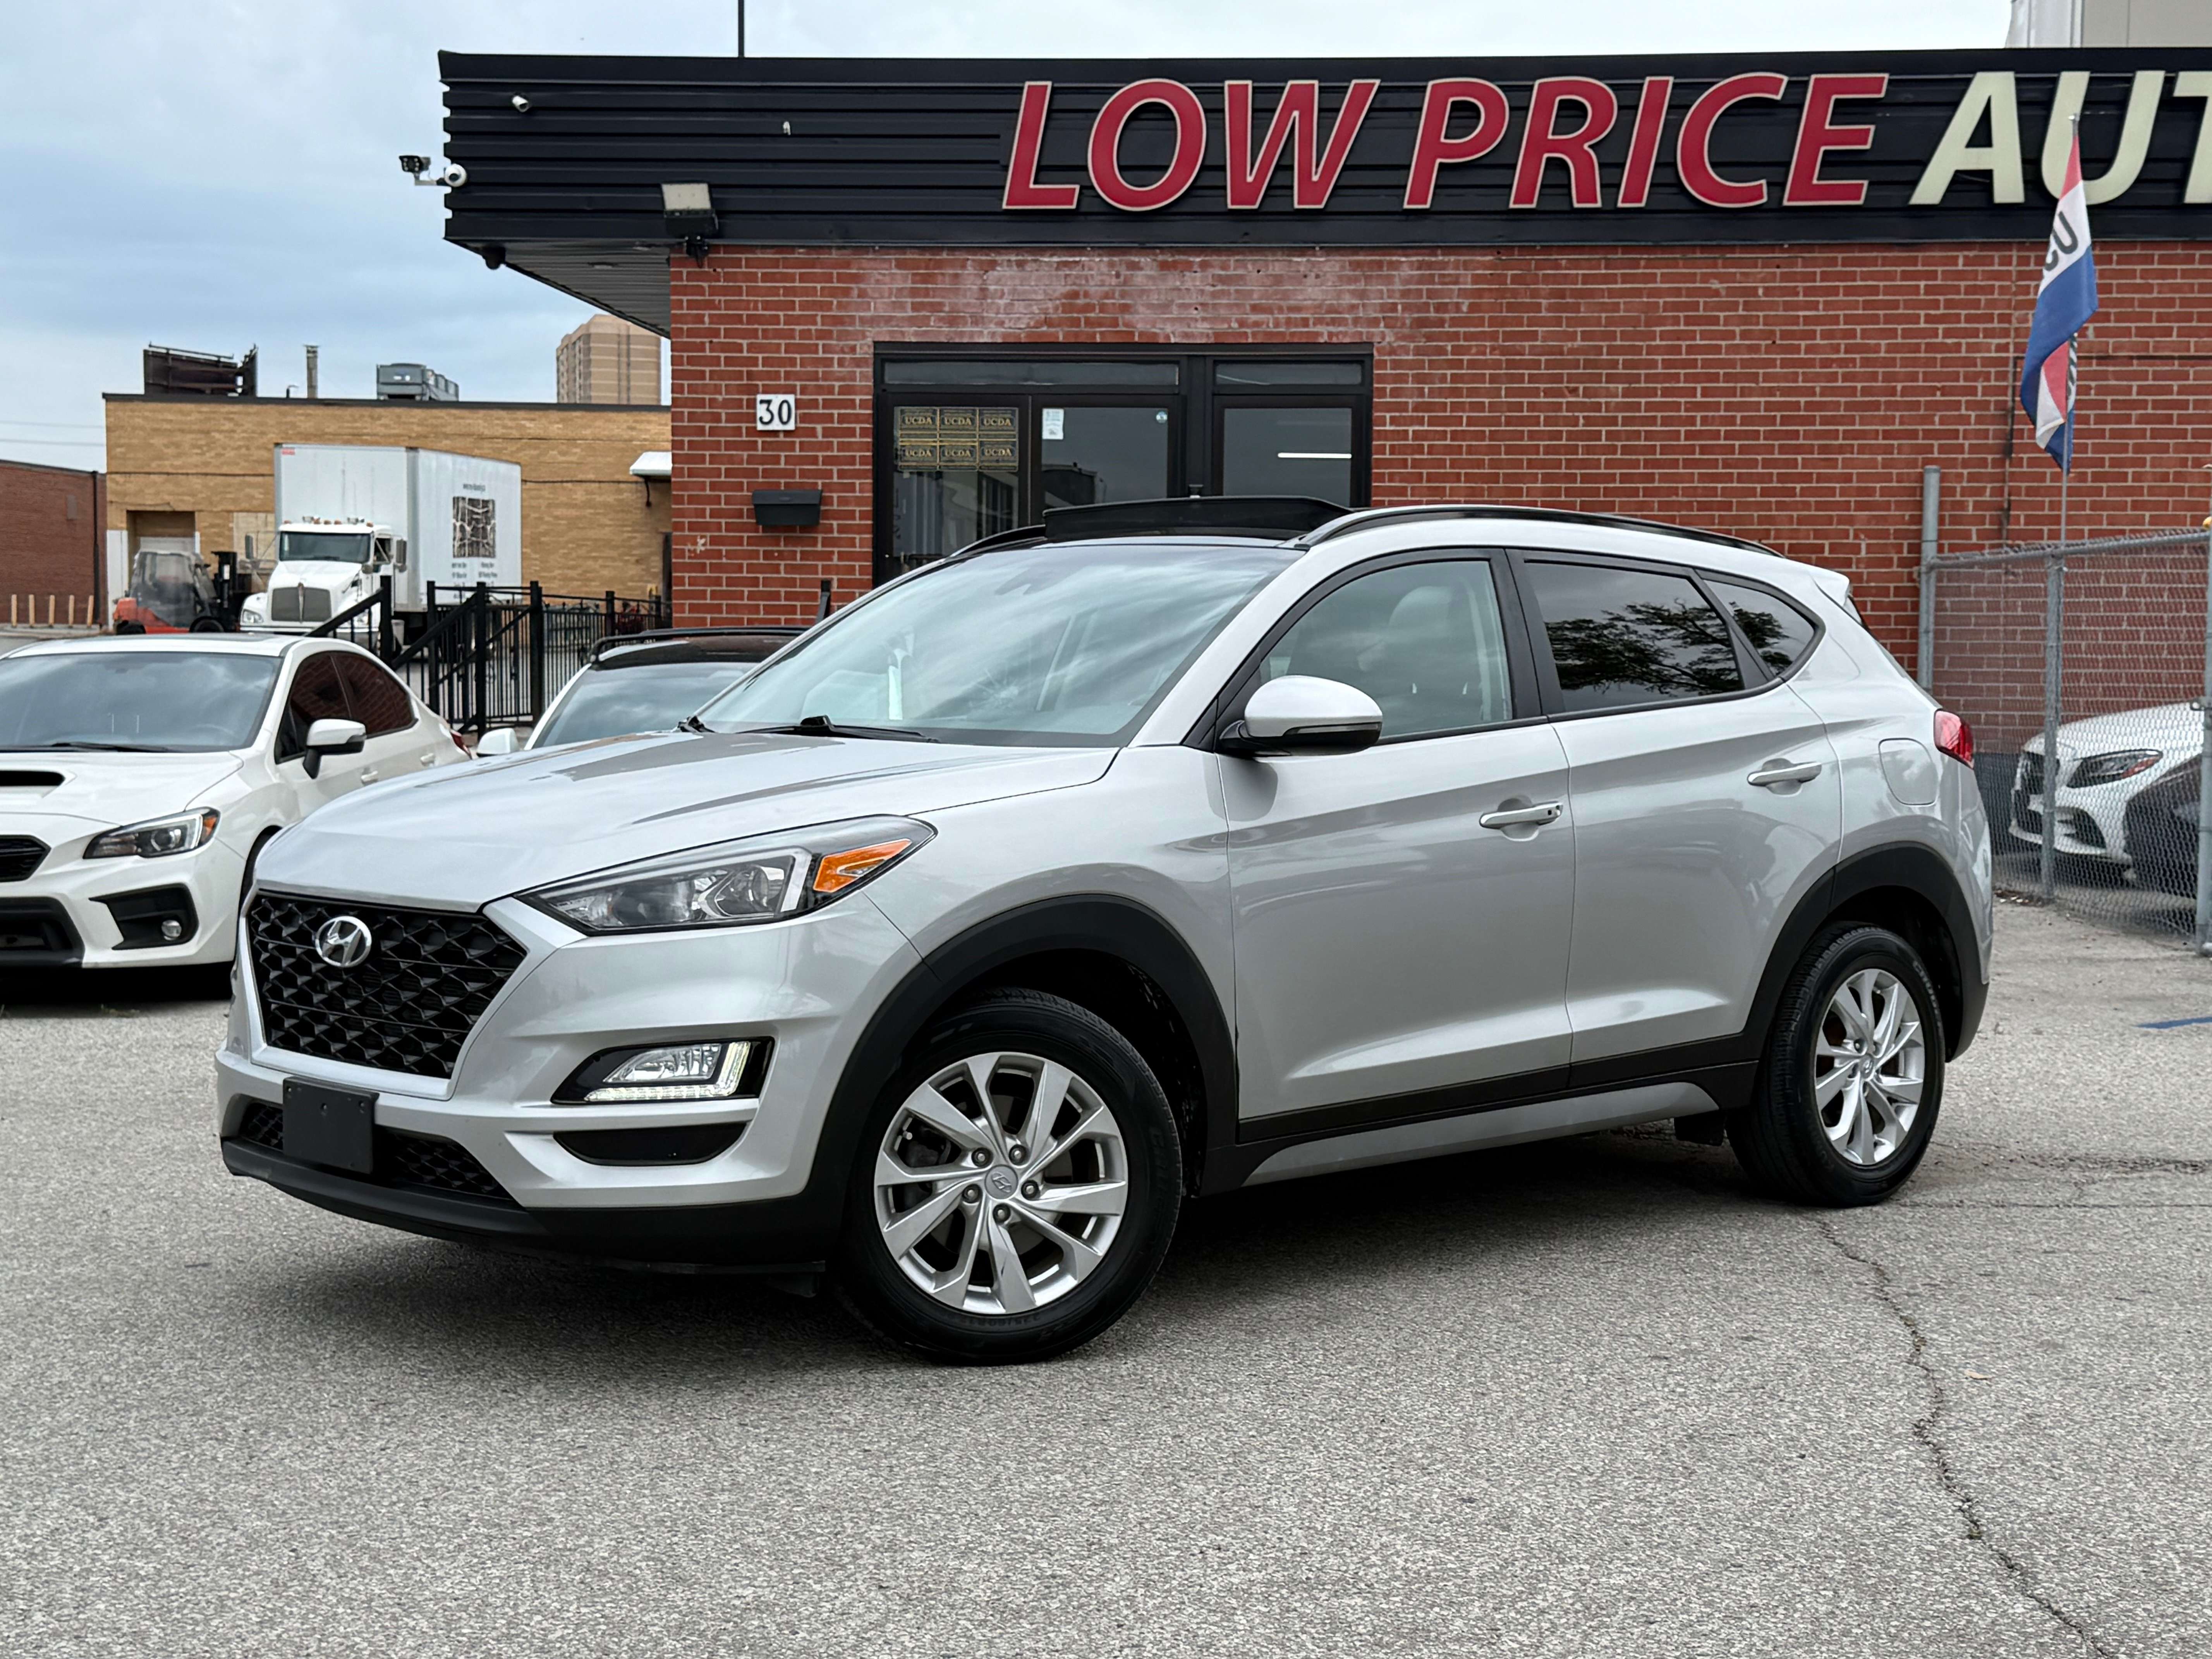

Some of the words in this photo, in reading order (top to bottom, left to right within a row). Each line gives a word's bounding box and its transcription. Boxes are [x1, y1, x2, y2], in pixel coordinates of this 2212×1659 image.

[1001, 77, 1382, 212] LOW
[1403, 72, 1889, 209] PRICE
[759, 399, 792, 425] 30
[905, 416, 933, 425] UCDA
[944, 417, 972, 426] UCDA
[983, 417, 1012, 426] UCDA
[905, 448, 932, 457] UCDA
[945, 448, 971, 457] UCDA
[985, 448, 1012, 457] UCDA
